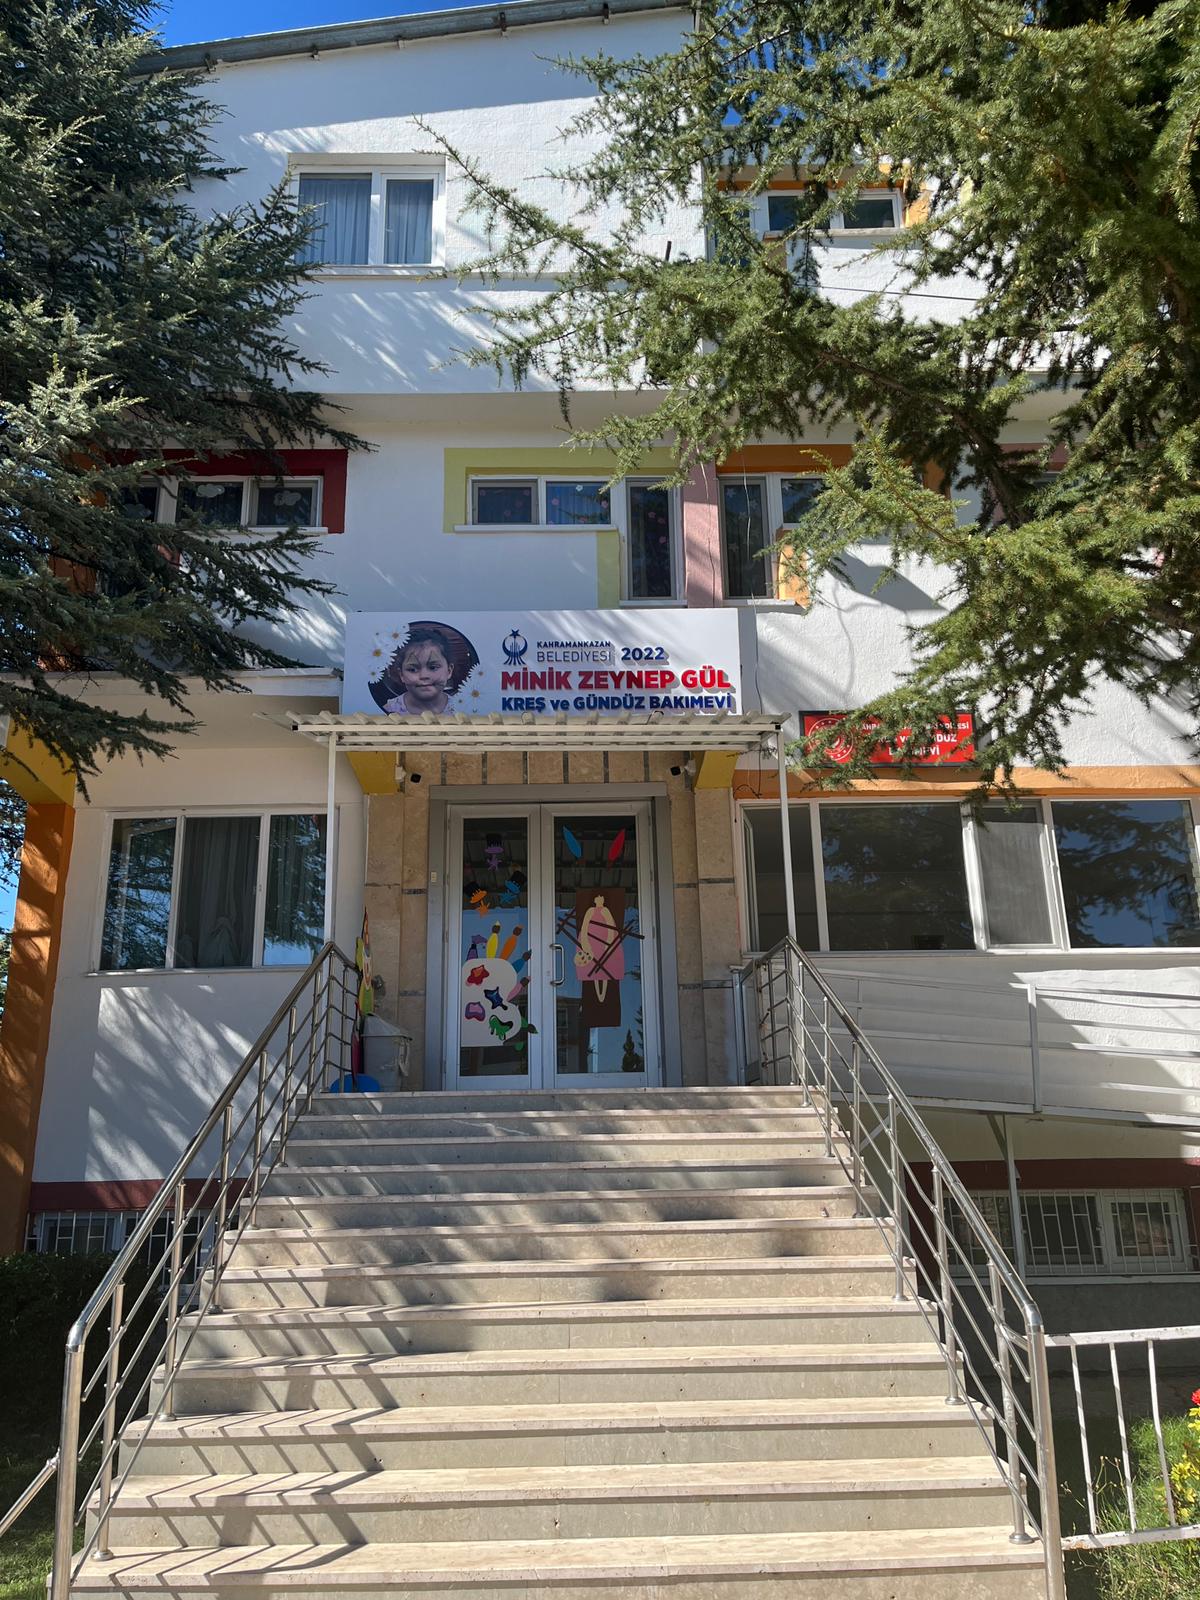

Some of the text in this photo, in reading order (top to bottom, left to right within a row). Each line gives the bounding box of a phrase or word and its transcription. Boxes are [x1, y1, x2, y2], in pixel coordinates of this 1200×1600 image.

[537, 640, 611, 648] KAHRAMANKAZAN
[621, 647, 665, 661] 2022
[501, 665, 731, 690] MİNİK ZEYNEP GÜL
[501, 692, 732, 713] KREŞ ve GÜNDÜZ BAKIMEVİ
